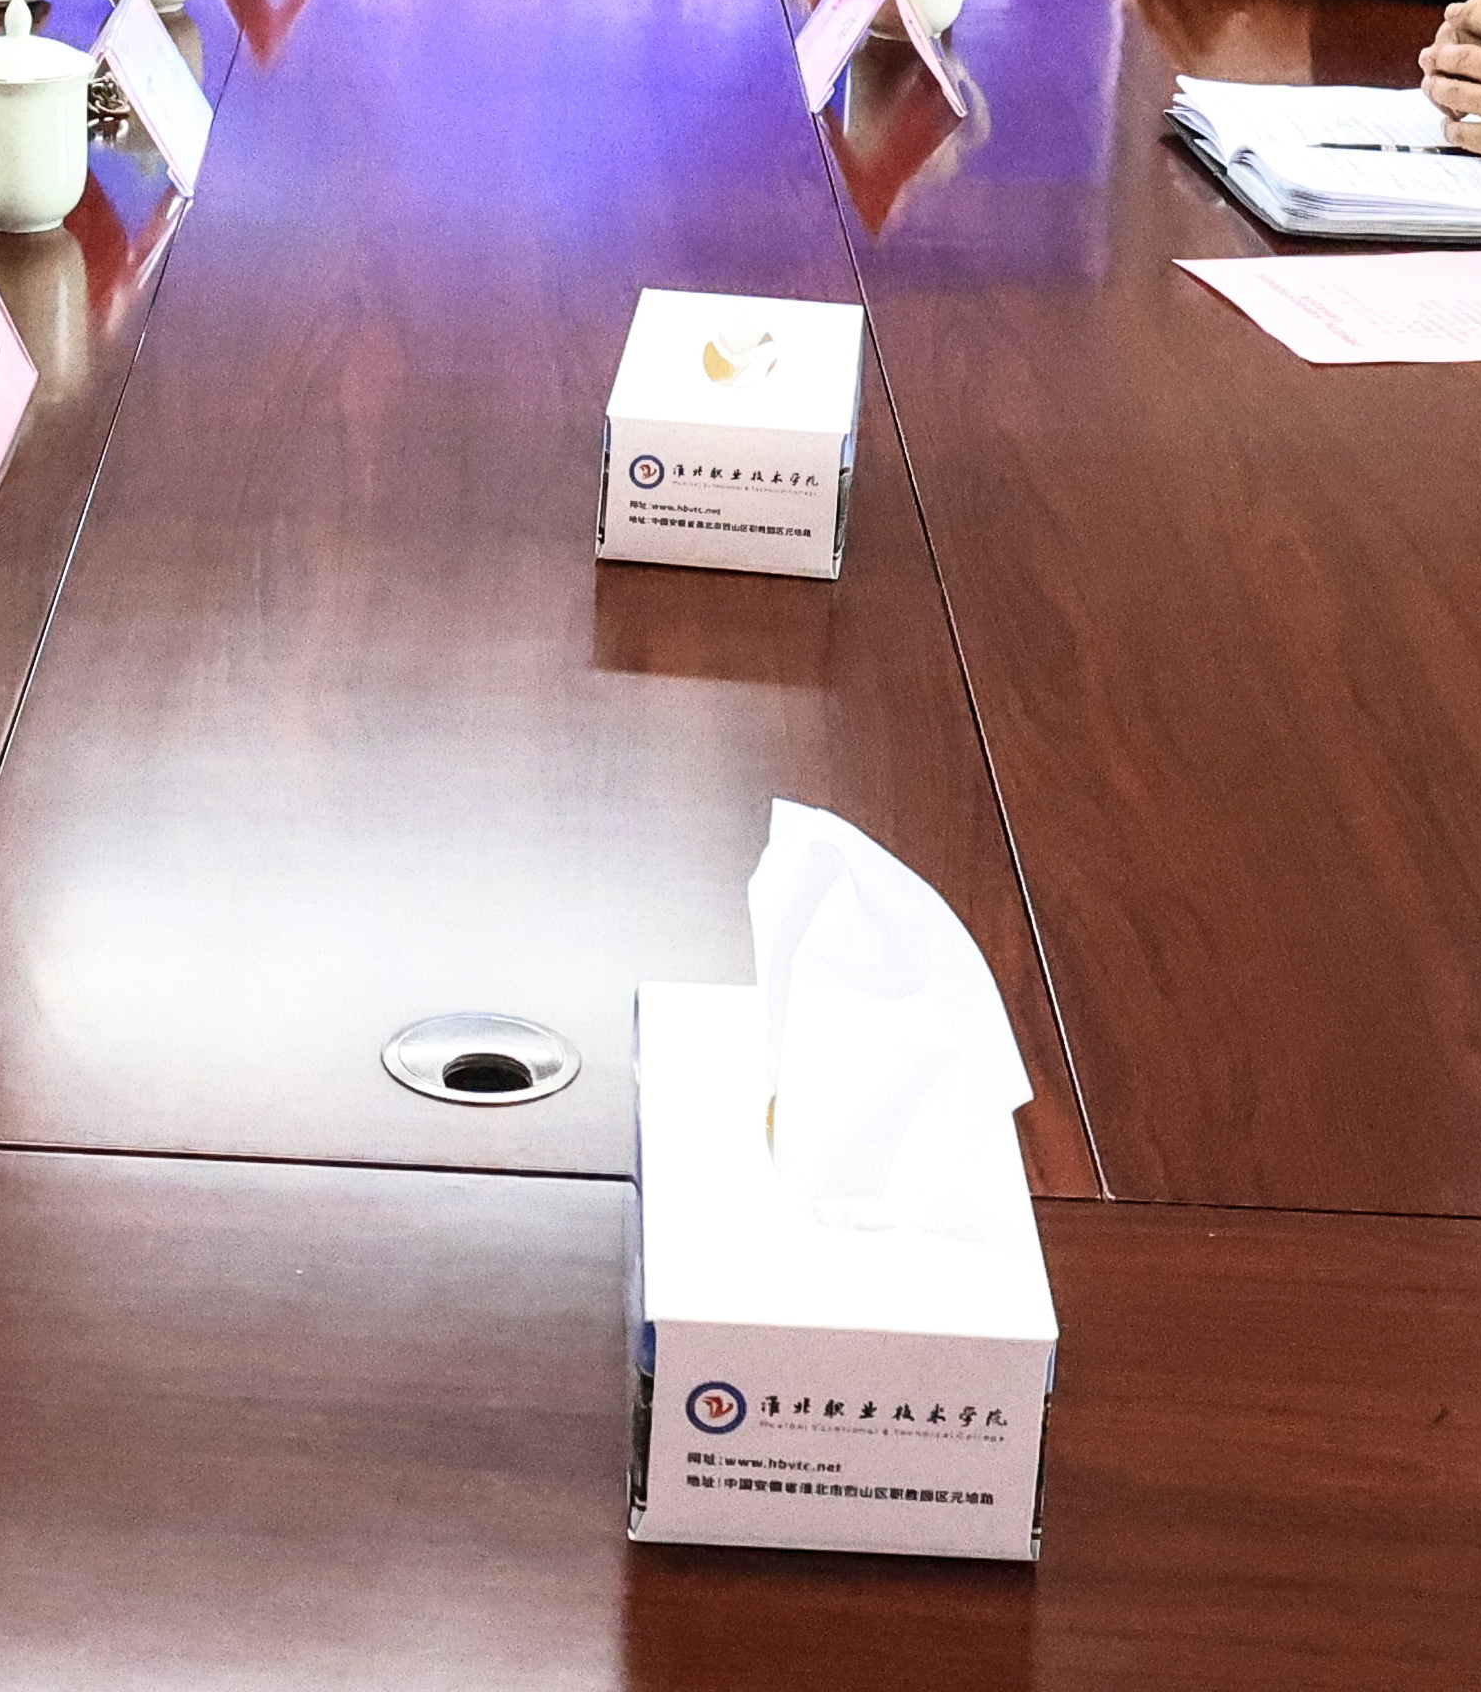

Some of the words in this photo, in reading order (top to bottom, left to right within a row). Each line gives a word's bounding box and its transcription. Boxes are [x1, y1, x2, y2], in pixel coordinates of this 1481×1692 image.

[760, 1394, 1009, 1428] 淮北职业技术学院
